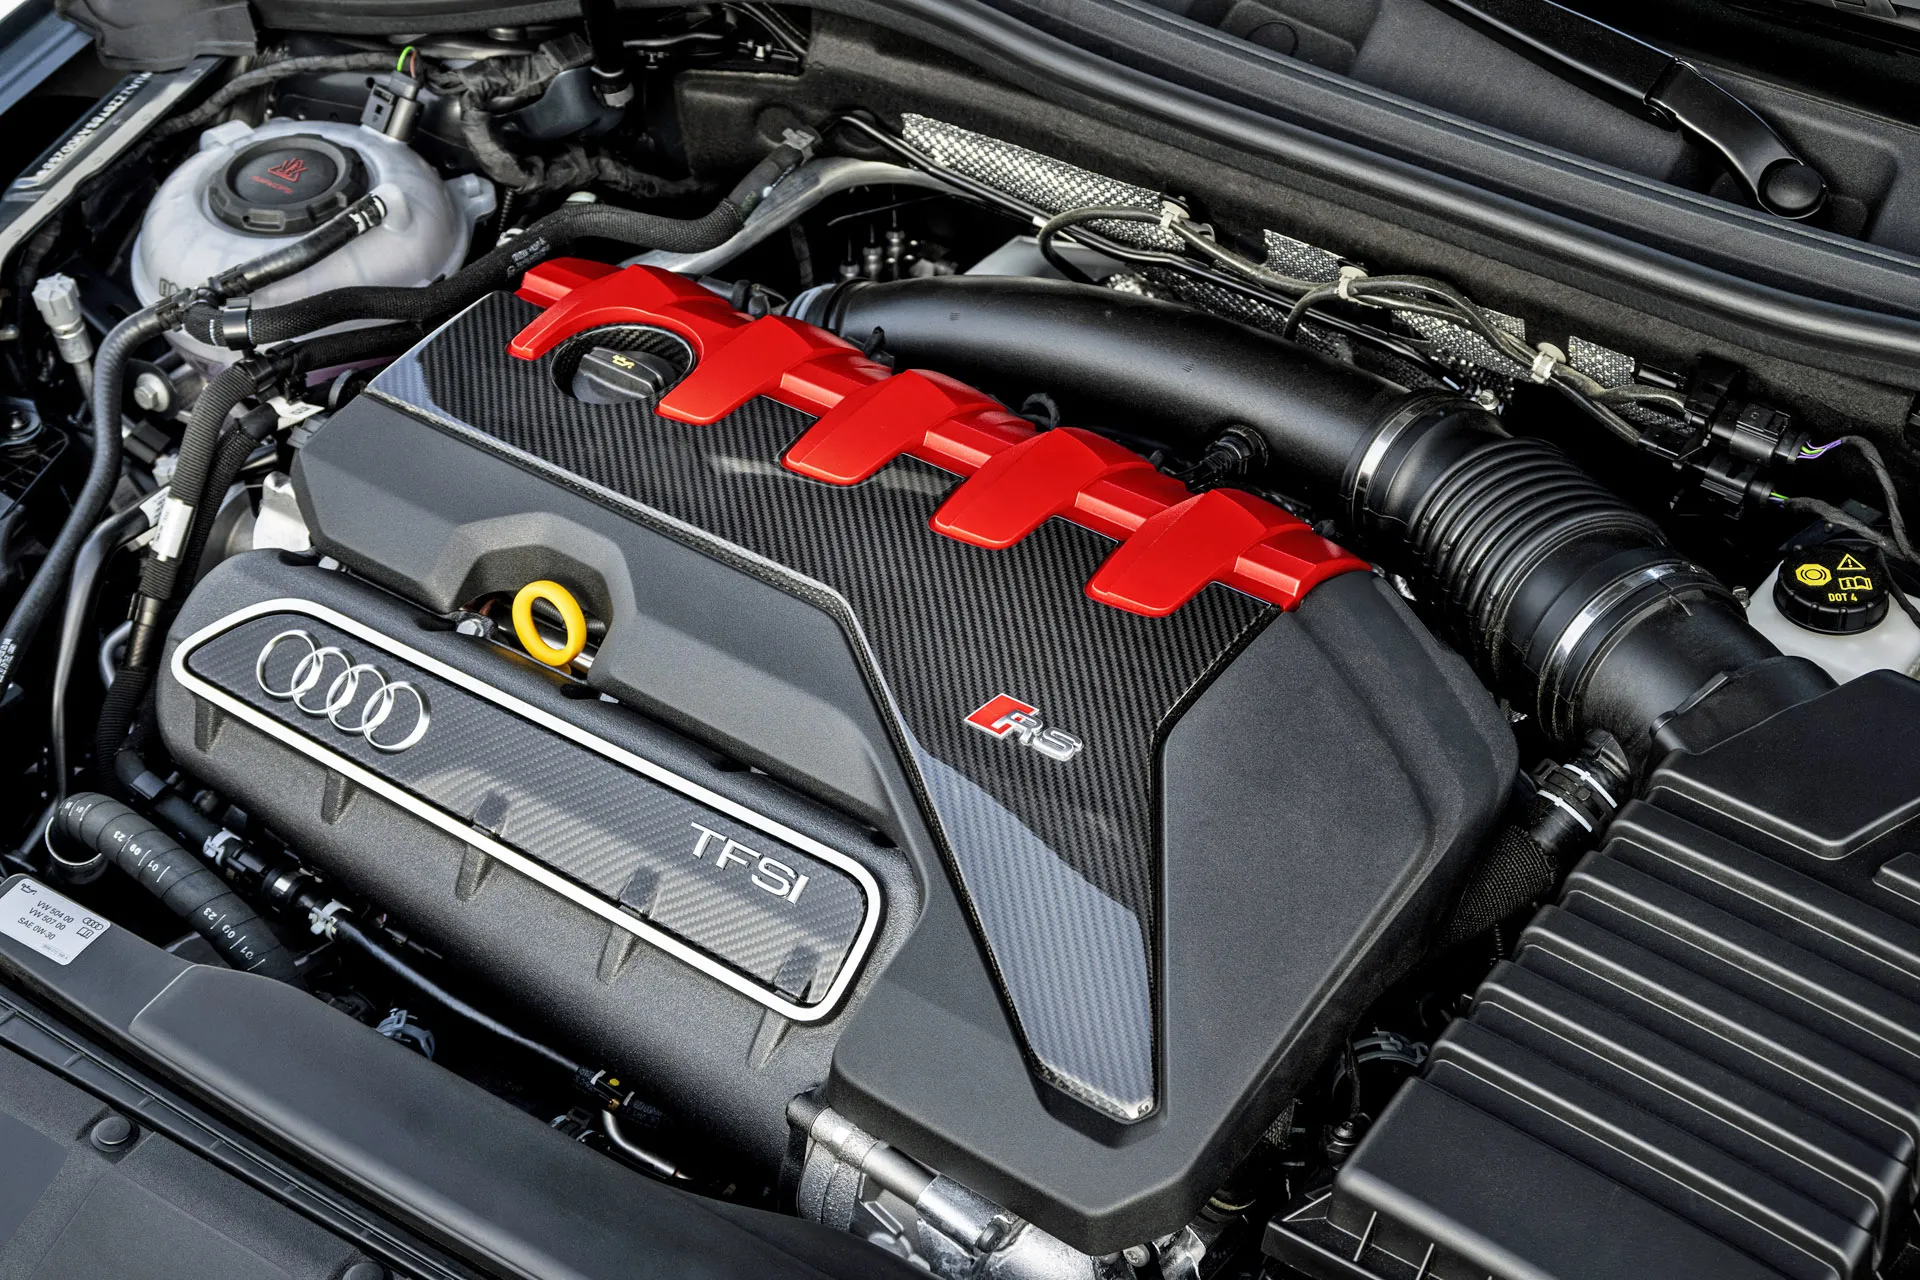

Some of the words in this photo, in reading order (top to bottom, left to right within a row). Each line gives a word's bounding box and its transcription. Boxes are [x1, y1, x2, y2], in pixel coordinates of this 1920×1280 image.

[1828, 593, 1848, 602] DOT
[1851, 593, 1858, 602] 4
[988, 707, 1084, 761] RS
[113, 830, 126, 842] 23
[129, 844, 142, 856] 09
[147, 860, 159, 872] 01
[691, 821, 810, 905] TFSI
[28, 907, 42, 918] VW
[41, 915, 57, 925] 507
[54, 922, 66, 931] 00
[36, 900, 52, 912] VW
[49, 908, 65, 918] 504
[62, 915, 75, 924] 00
[203, 907, 218, 921] 23
[17, 916, 35, 929] SAE
[32, 924, 56, 940] 0W-30
